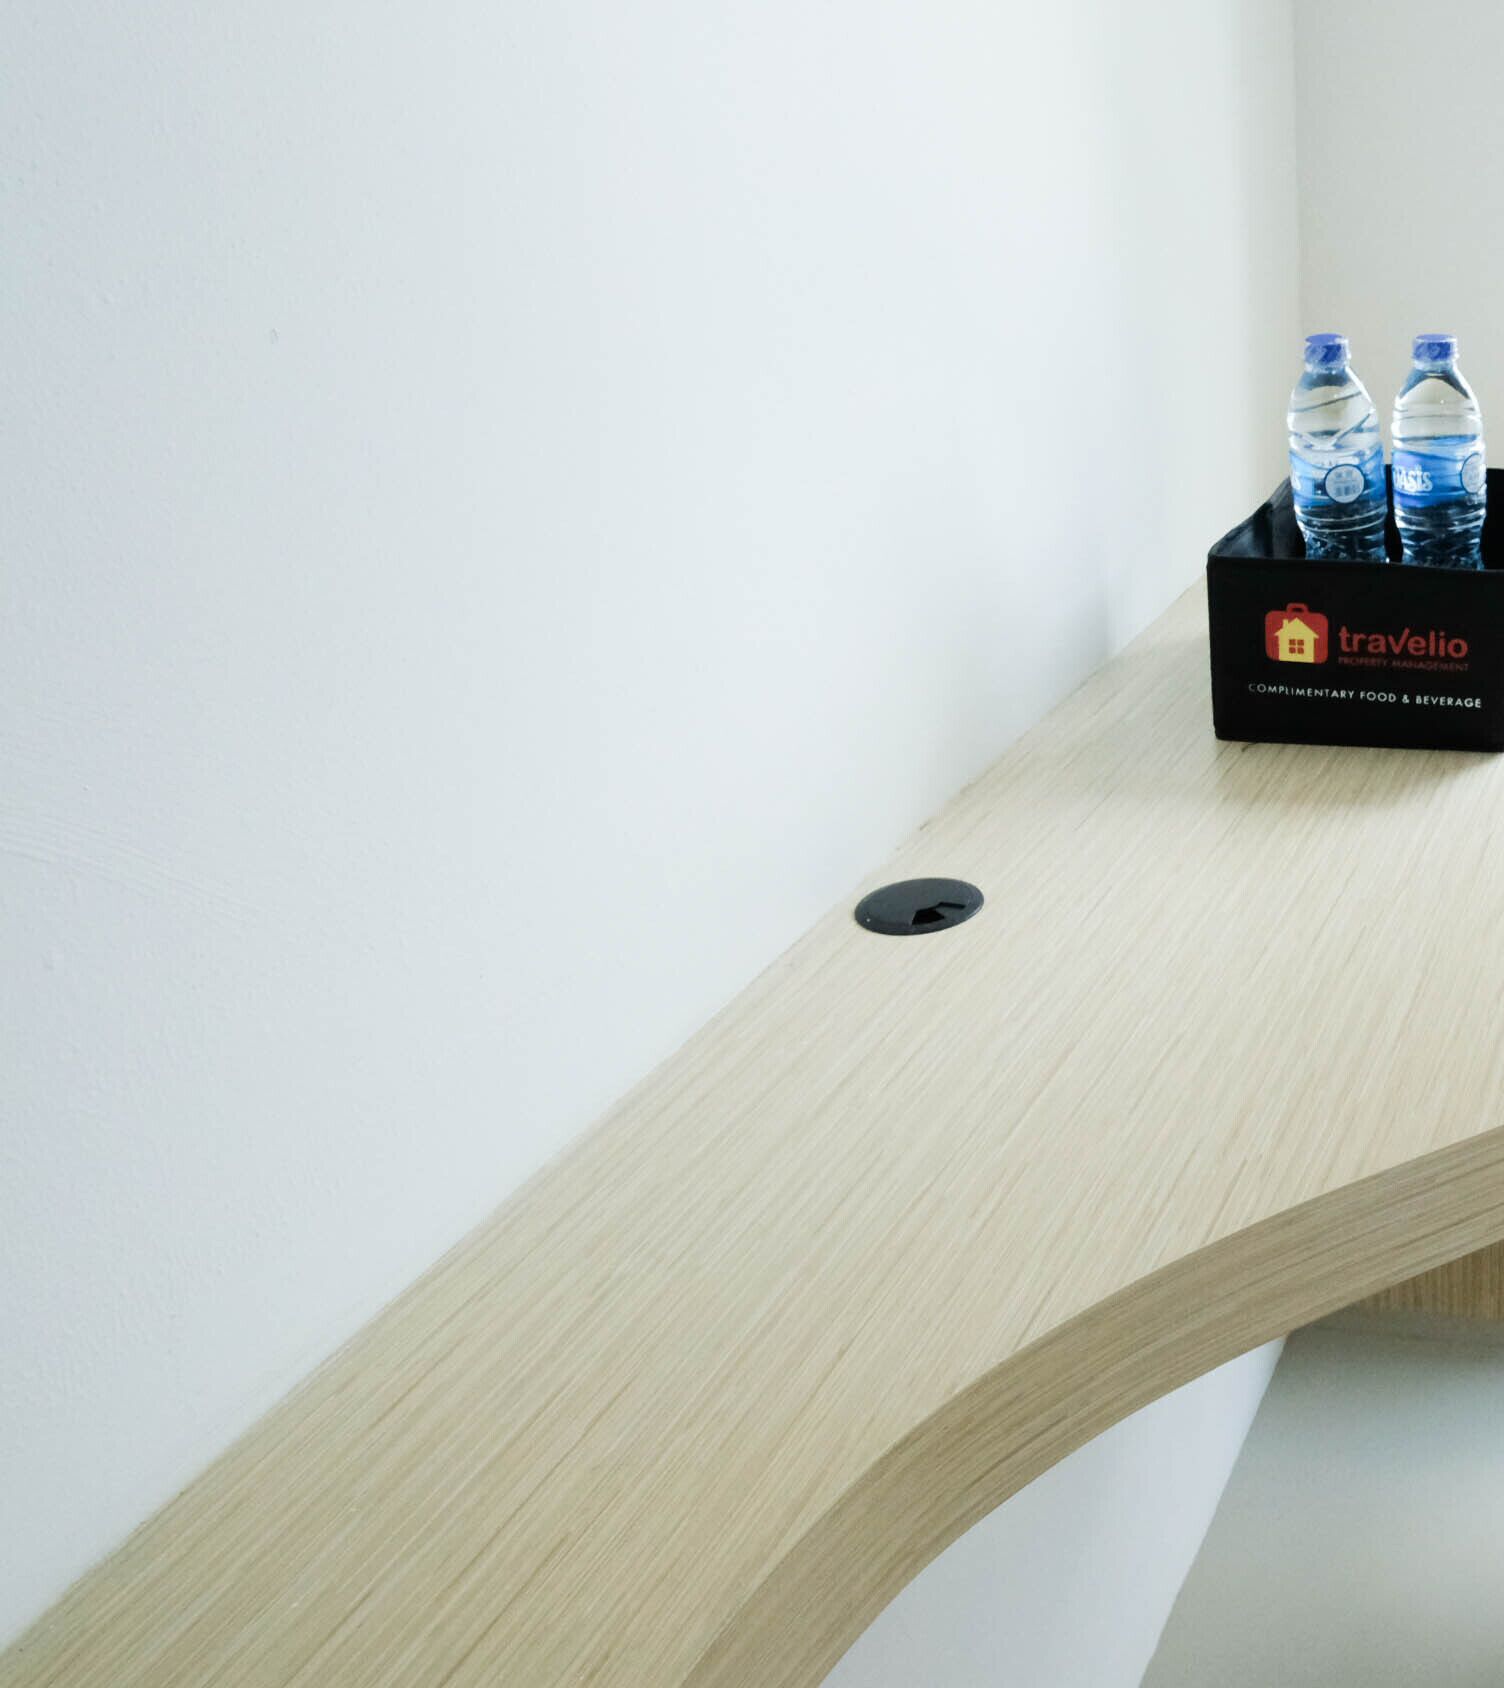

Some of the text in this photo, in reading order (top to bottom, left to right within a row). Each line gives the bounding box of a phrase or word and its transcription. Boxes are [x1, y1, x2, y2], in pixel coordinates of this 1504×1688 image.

[1338, 656, 1469, 672] PROPERTY MANAGEMENT
[1249, 683, 1482, 709] COMPLIMENTARY FOOD & BEVERAGE
